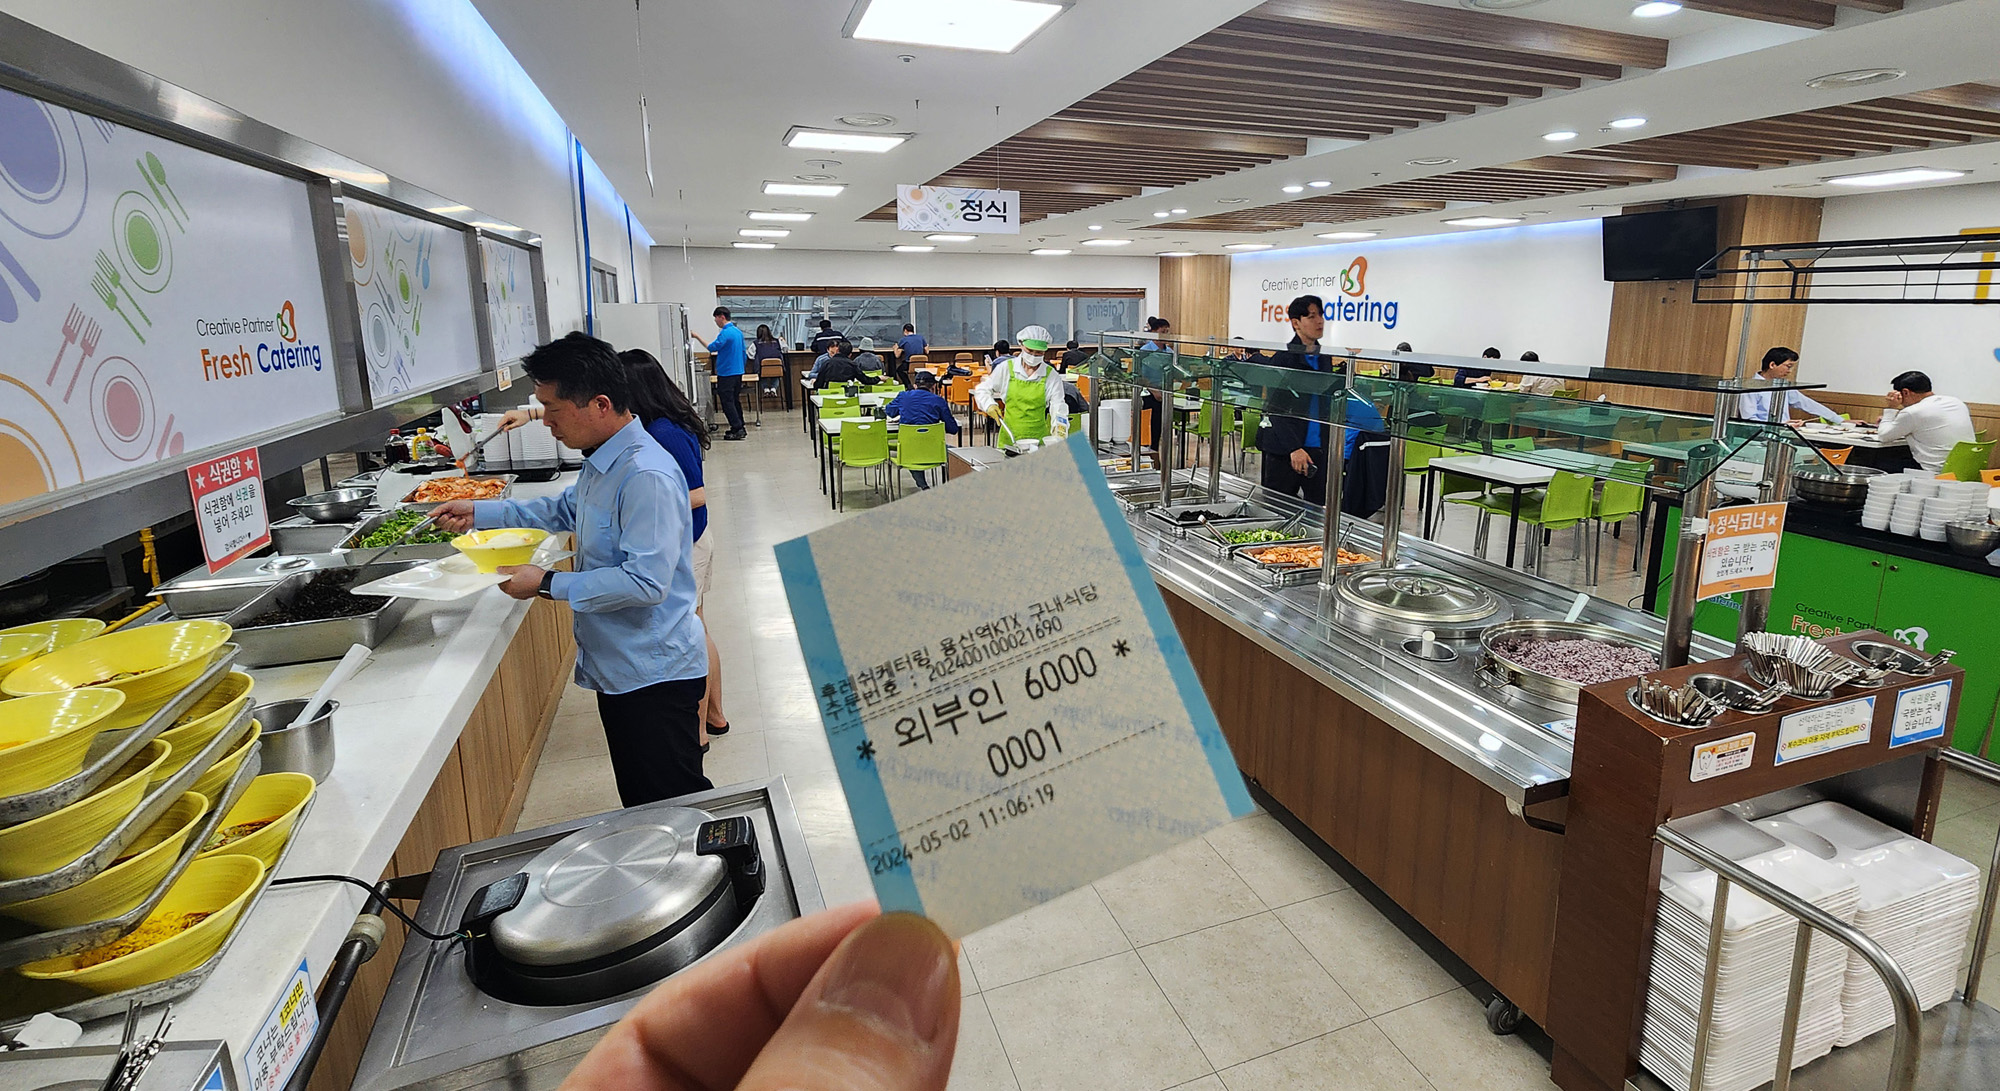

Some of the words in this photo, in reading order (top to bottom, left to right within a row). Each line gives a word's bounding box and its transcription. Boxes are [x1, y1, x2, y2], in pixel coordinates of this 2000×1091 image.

[960, 199, 1007, 223] 정식
[1261, 278, 1299, 291] Creative
[1301, 274, 1336, 290] Partner
[196, 317, 241, 336] Creative
[242, 317, 274, 334] Partner
[1261, 299, 1290, 322] Fres
[1323, 294, 1398, 330] atering
[200, 344, 253, 381] Fresh
[257, 339, 322, 373] Catering
[209, 456, 242, 485] 식권함
[203, 493, 235, 517] 식권함에
[213, 513, 230, 533] 넣어
[1716, 511, 1766, 535] 정식코너
[1720, 555, 1753, 569] 있습니다!
[940, 612, 1022, 657] 용산역KTX
[1028, 582, 1098, 621] 구내식당
[1795, 602, 1844, 624] Creative
[825, 679, 902, 721] 주문번호
[895, 679, 1008, 747] 외부인
[1025, 646, 1097, 700] 6000
[987, 720, 1062, 777] 0001
[870, 818, 971, 875] 2024-05-02
[978, 783, 1055, 829] 11:06:19
[256, 1024, 279, 1065] 코너는
[279, 979, 304, 1024] 1코너만
[254, 1061, 269, 1091] 이용
[269, 991, 312, 1063] 부탁드립니다.
[281, 1042, 294, 1064] 이용
